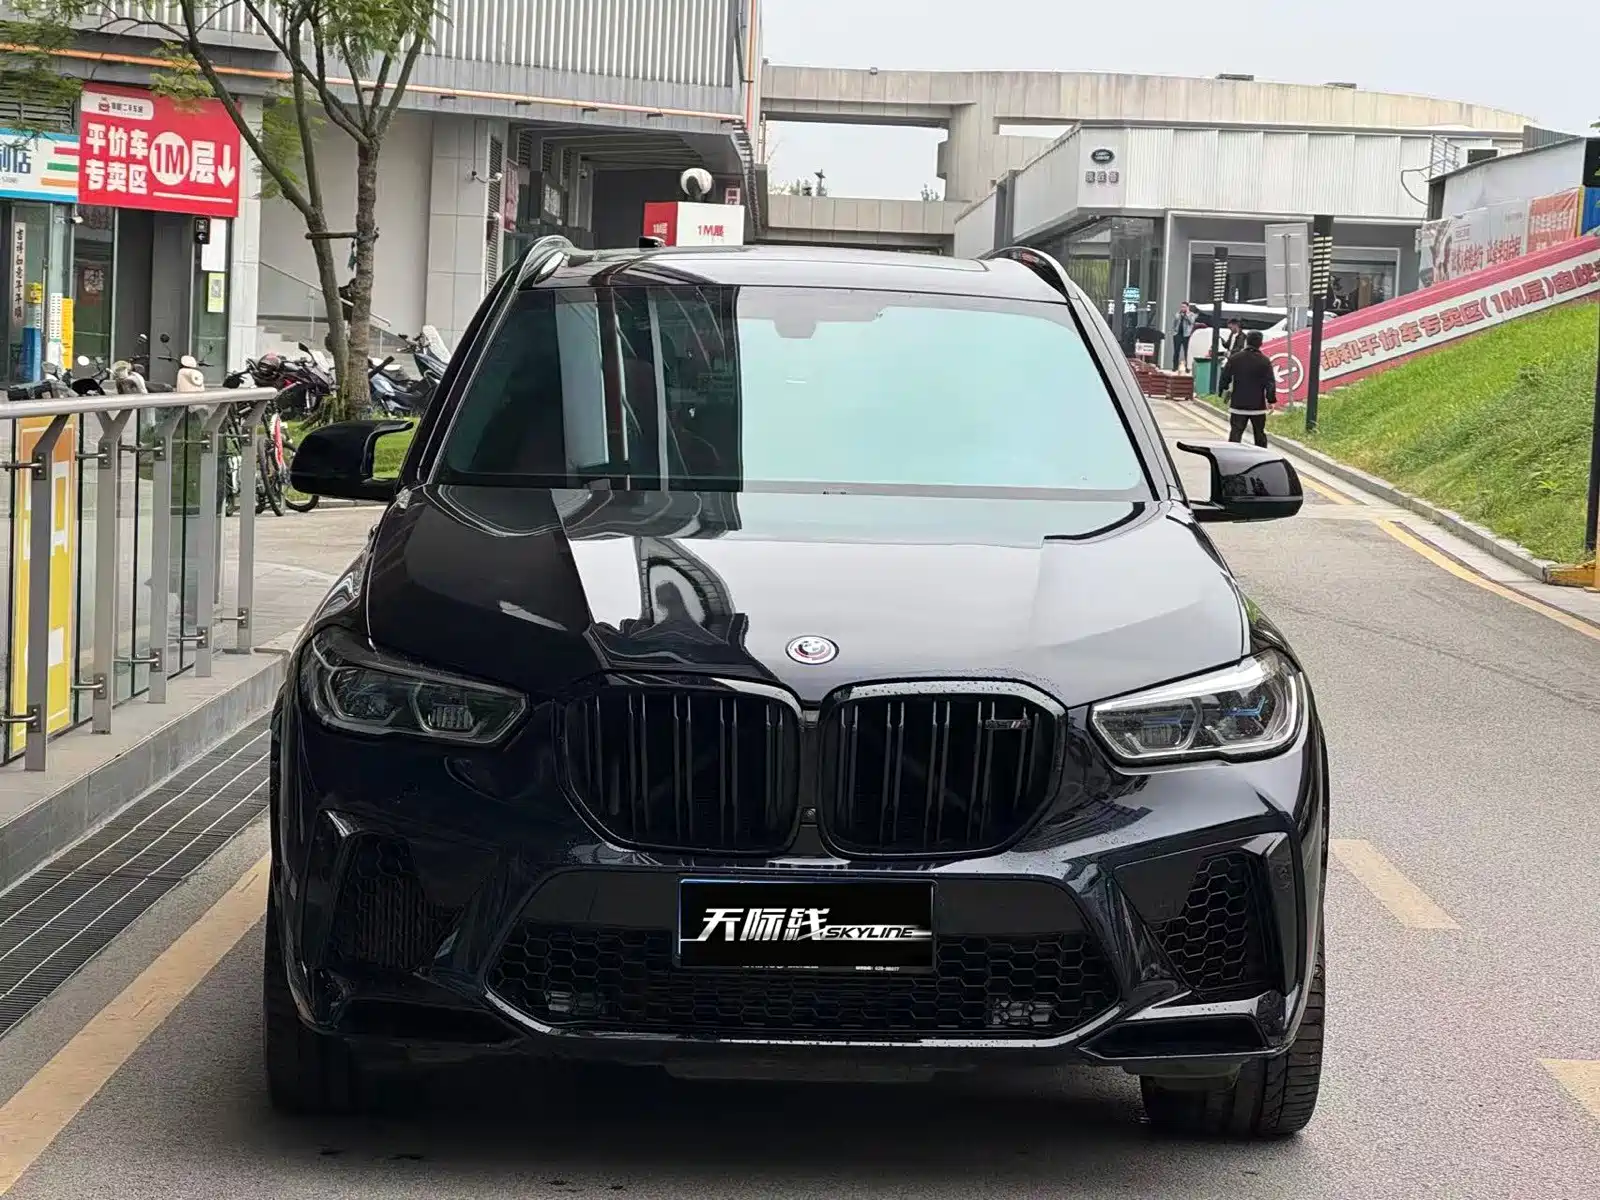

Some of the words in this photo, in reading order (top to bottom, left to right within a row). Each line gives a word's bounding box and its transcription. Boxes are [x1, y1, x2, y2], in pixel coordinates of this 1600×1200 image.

[86, 122, 149, 160] 平价车
[85, 159, 148, 195] 专卖区
